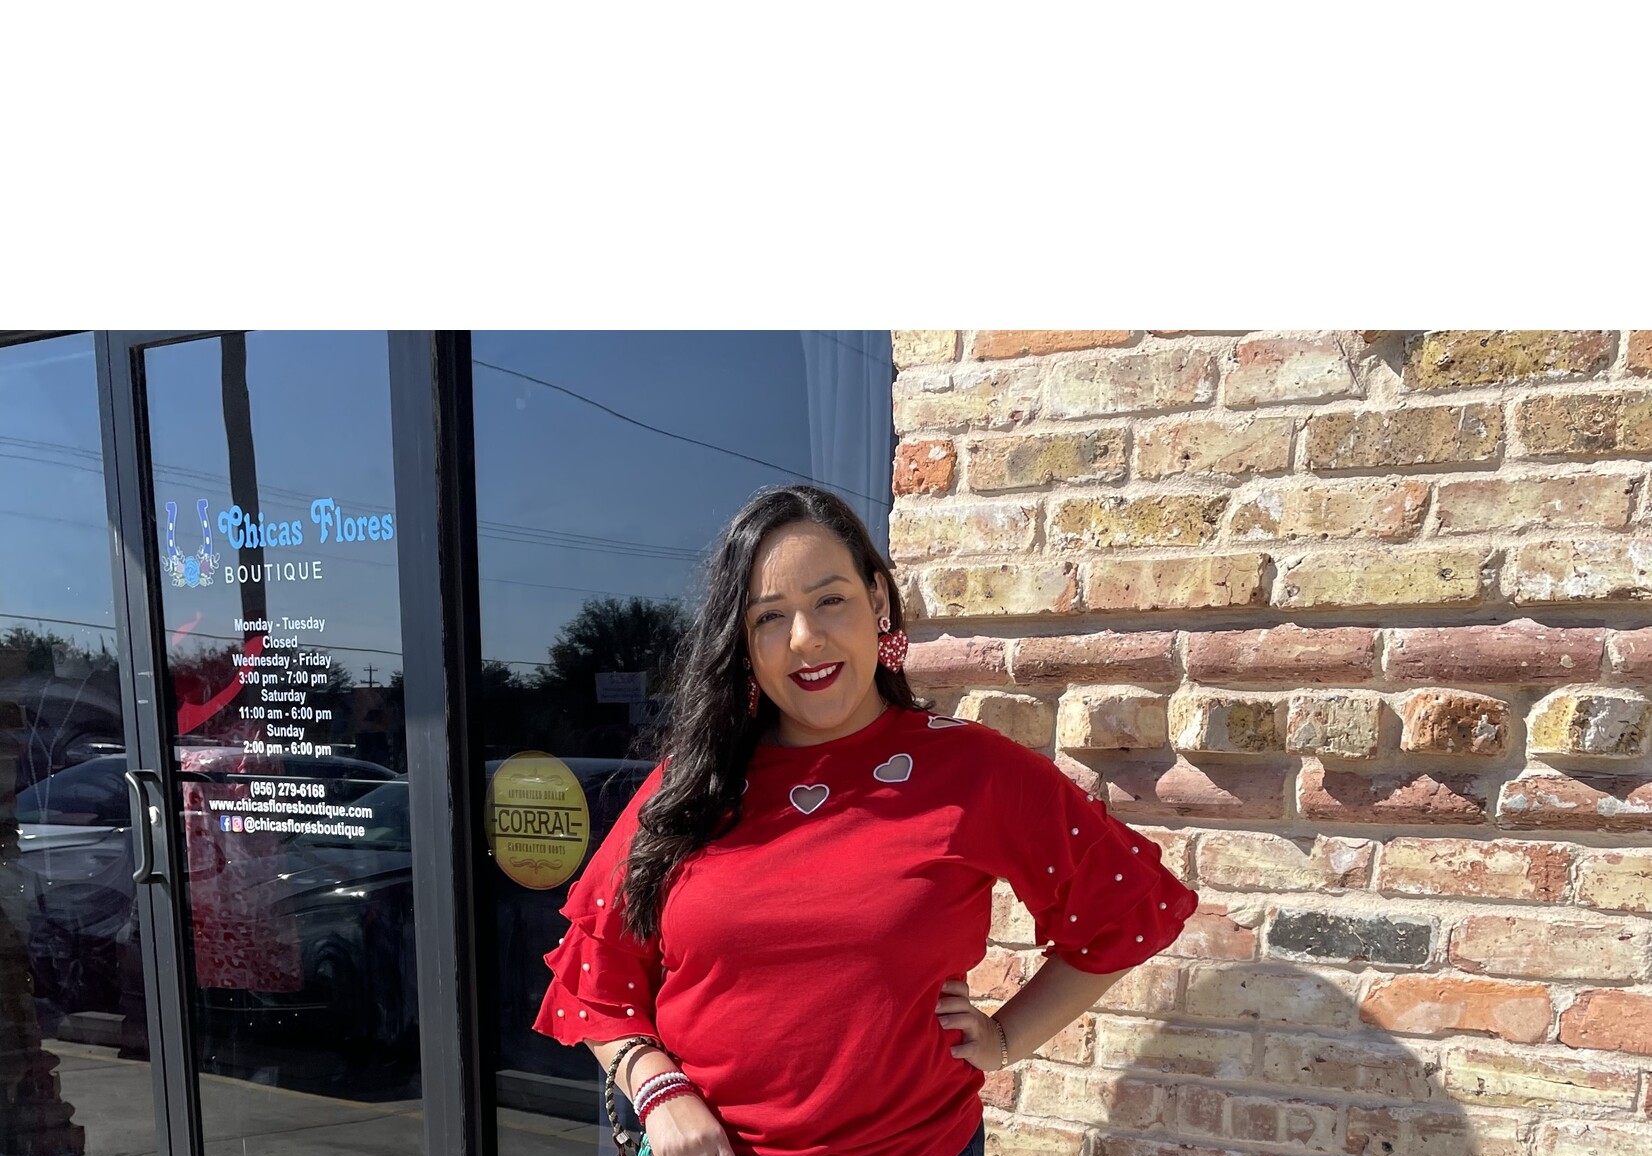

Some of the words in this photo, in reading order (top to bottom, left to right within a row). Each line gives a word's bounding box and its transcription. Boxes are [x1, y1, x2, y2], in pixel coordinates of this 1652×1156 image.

[218, 505, 303, 549] Chicas
[311, 497, 394, 543] Flores
[225, 561, 323, 583] BOUTIQUE
[234, 618, 273, 633] Monday
[282, 617, 325, 632] Tuesday
[262, 635, 298, 649] Closed
[232, 653, 290, 668] Wednesday
[299, 652, 331, 668] Friday
[239, 671, 260, 684] 3:00
[262, 674, 278, 687] pm
[287, 671, 308, 684] 7:00
[311, 674, 327, 687] pm
[261, 689, 306, 705] Saturday
[239, 706, 265, 719] 11:00
[267, 709, 282, 720] am
[291, 706, 313, 720] 6:00
[315, 709, 332, 722] pm
[267, 724, 304, 740] Sunday
[243, 740, 264, 754] 2:00
[267, 743, 282, 756] pm
[291, 741, 313, 755] 6:00
[315, 744, 332, 758] pm
[250, 782, 275, 798] (956)
[278, 783, 325, 798] 279-6168
[209, 799, 372, 819] www.chicasfloresboutique.com
[244, 817, 365, 839] @chicasfloresboutique
[498, 809, 577, 836] CORRAL
